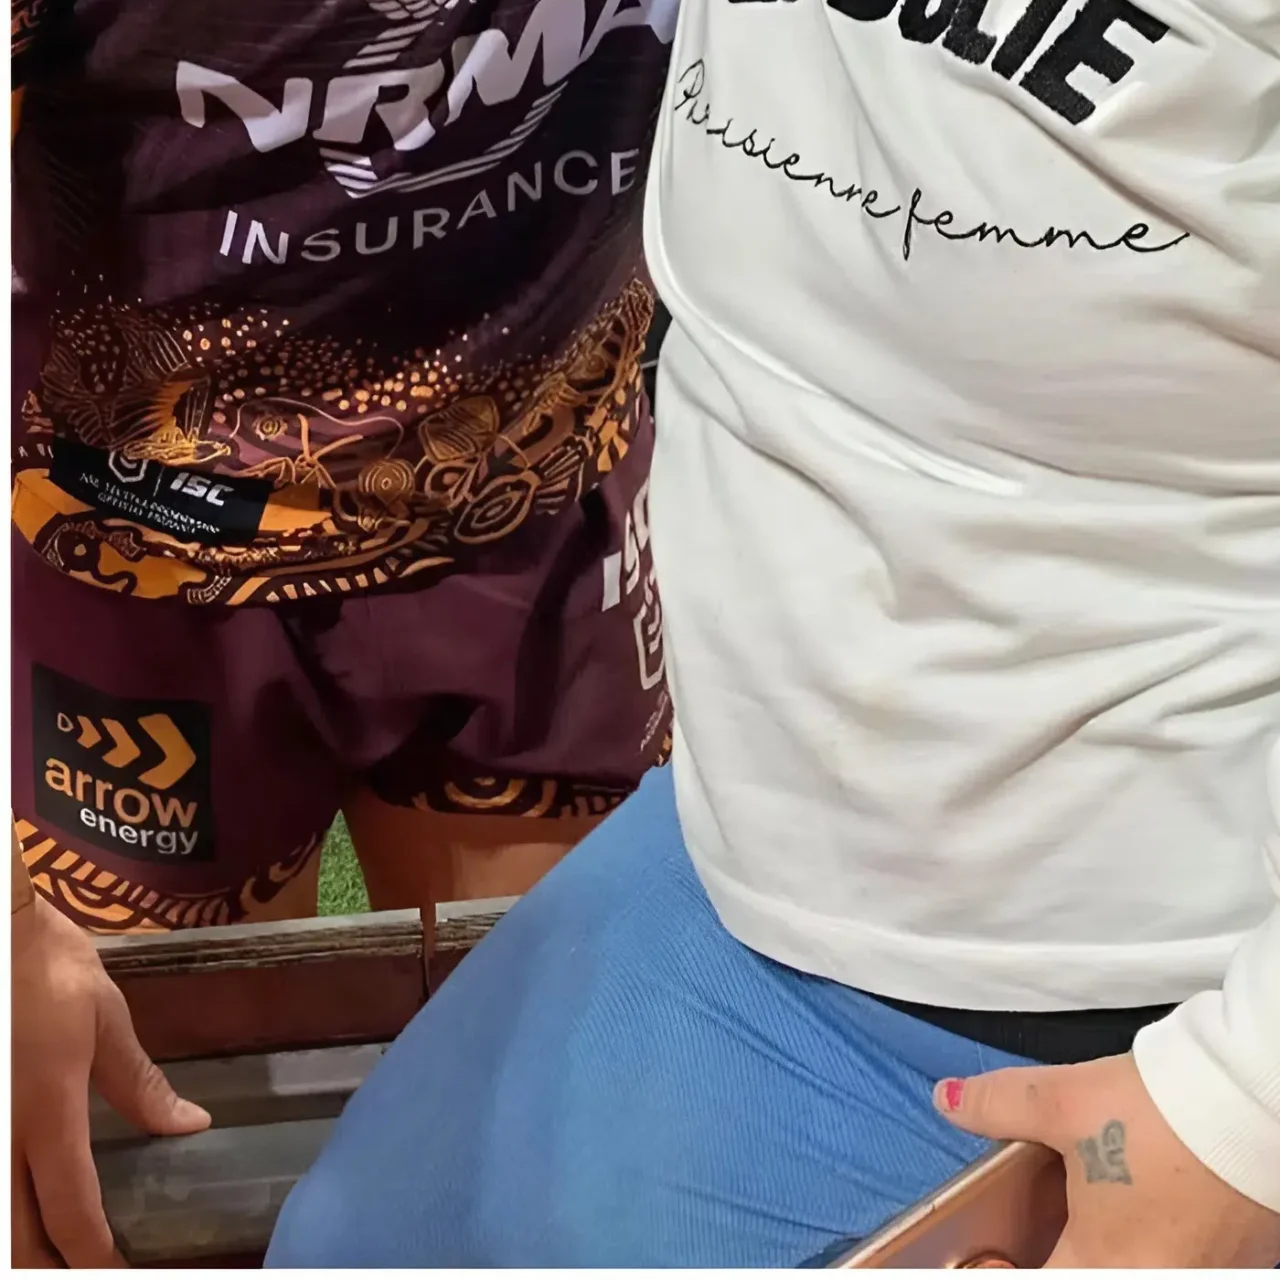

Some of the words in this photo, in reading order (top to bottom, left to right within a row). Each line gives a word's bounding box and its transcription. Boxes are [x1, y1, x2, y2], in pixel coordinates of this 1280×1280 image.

[218, 147, 641, 267] INSURANCE
[902, 188, 1191, 260] femme
[169, 471, 235, 507] ISC
[44, 757, 198, 829] arrow
[79, 806, 199, 855] energy
